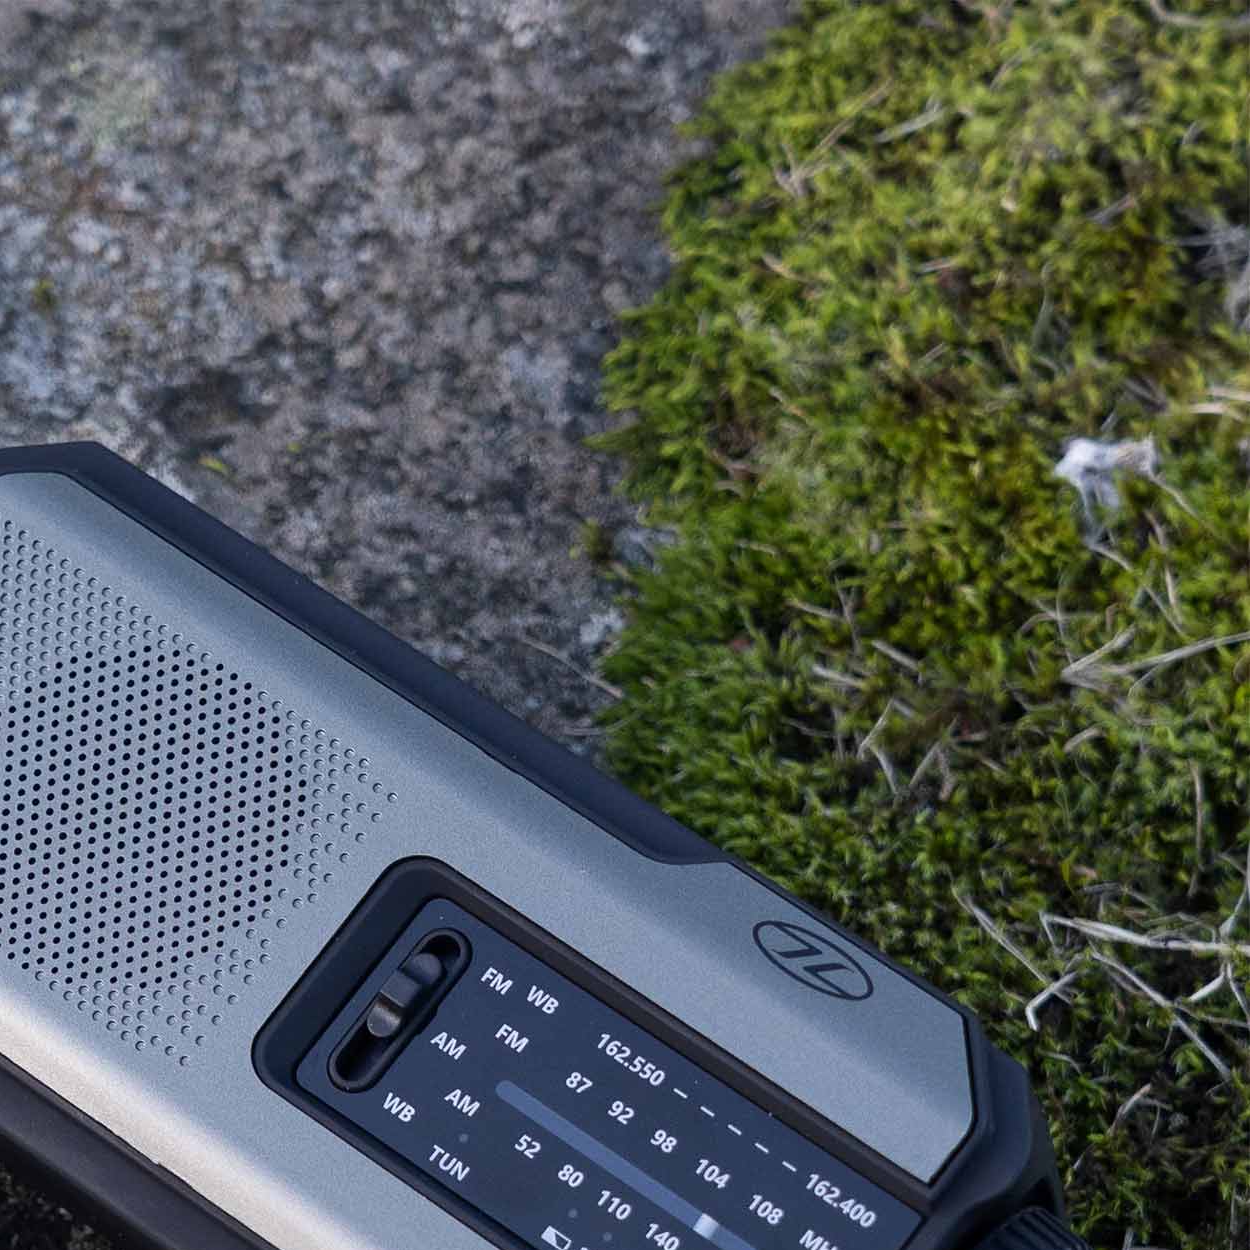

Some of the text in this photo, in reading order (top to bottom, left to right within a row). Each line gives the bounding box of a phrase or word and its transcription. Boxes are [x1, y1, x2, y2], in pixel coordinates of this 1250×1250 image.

[480, 967, 514, 995] FM
[429, 1031, 467, 1060] AM
[382, 1092, 416, 1123] WB
[494, 1023, 530, 1053] FM
[565, 1071, 593, 1094] 87
[607, 1100, 635, 1125] 92
[650, 1129, 678, 1153] 98
[695, 1159, 731, 1189] 104
[748, 1194, 784, 1225] 108
[526, 985, 877, 1228] WB 162.550 162.400
[428, 1144, 471, 1182] TUN
[443, 1088, 481, 1117] AM
[514, 1134, 542, 1159] 52
[557, 1164, 585, 1188] 80
[597, 1190, 632, 1221] 110
